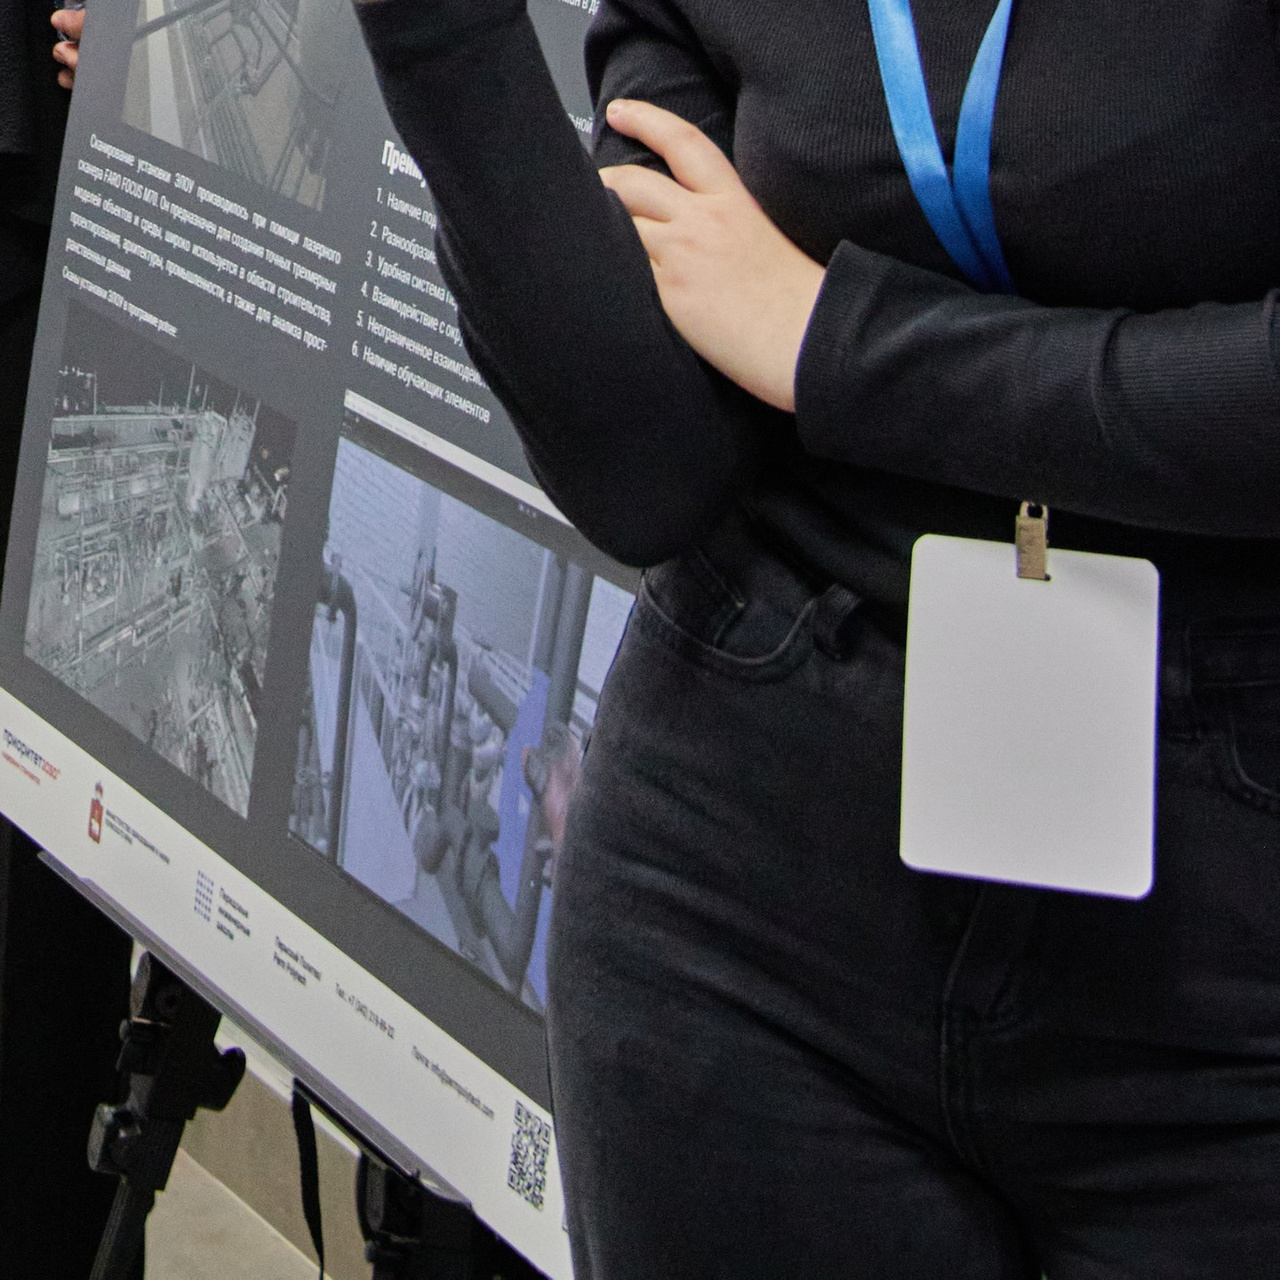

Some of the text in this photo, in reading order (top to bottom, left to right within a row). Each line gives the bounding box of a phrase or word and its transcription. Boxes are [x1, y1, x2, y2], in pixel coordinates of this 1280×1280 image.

[376, 255, 411, 285] Удобная
[411, 275, 446, 301] система
[362, 345, 397, 376] Наличие
[397, 365, 444, 400] обучающих
[443, 389, 490, 424] элементов
